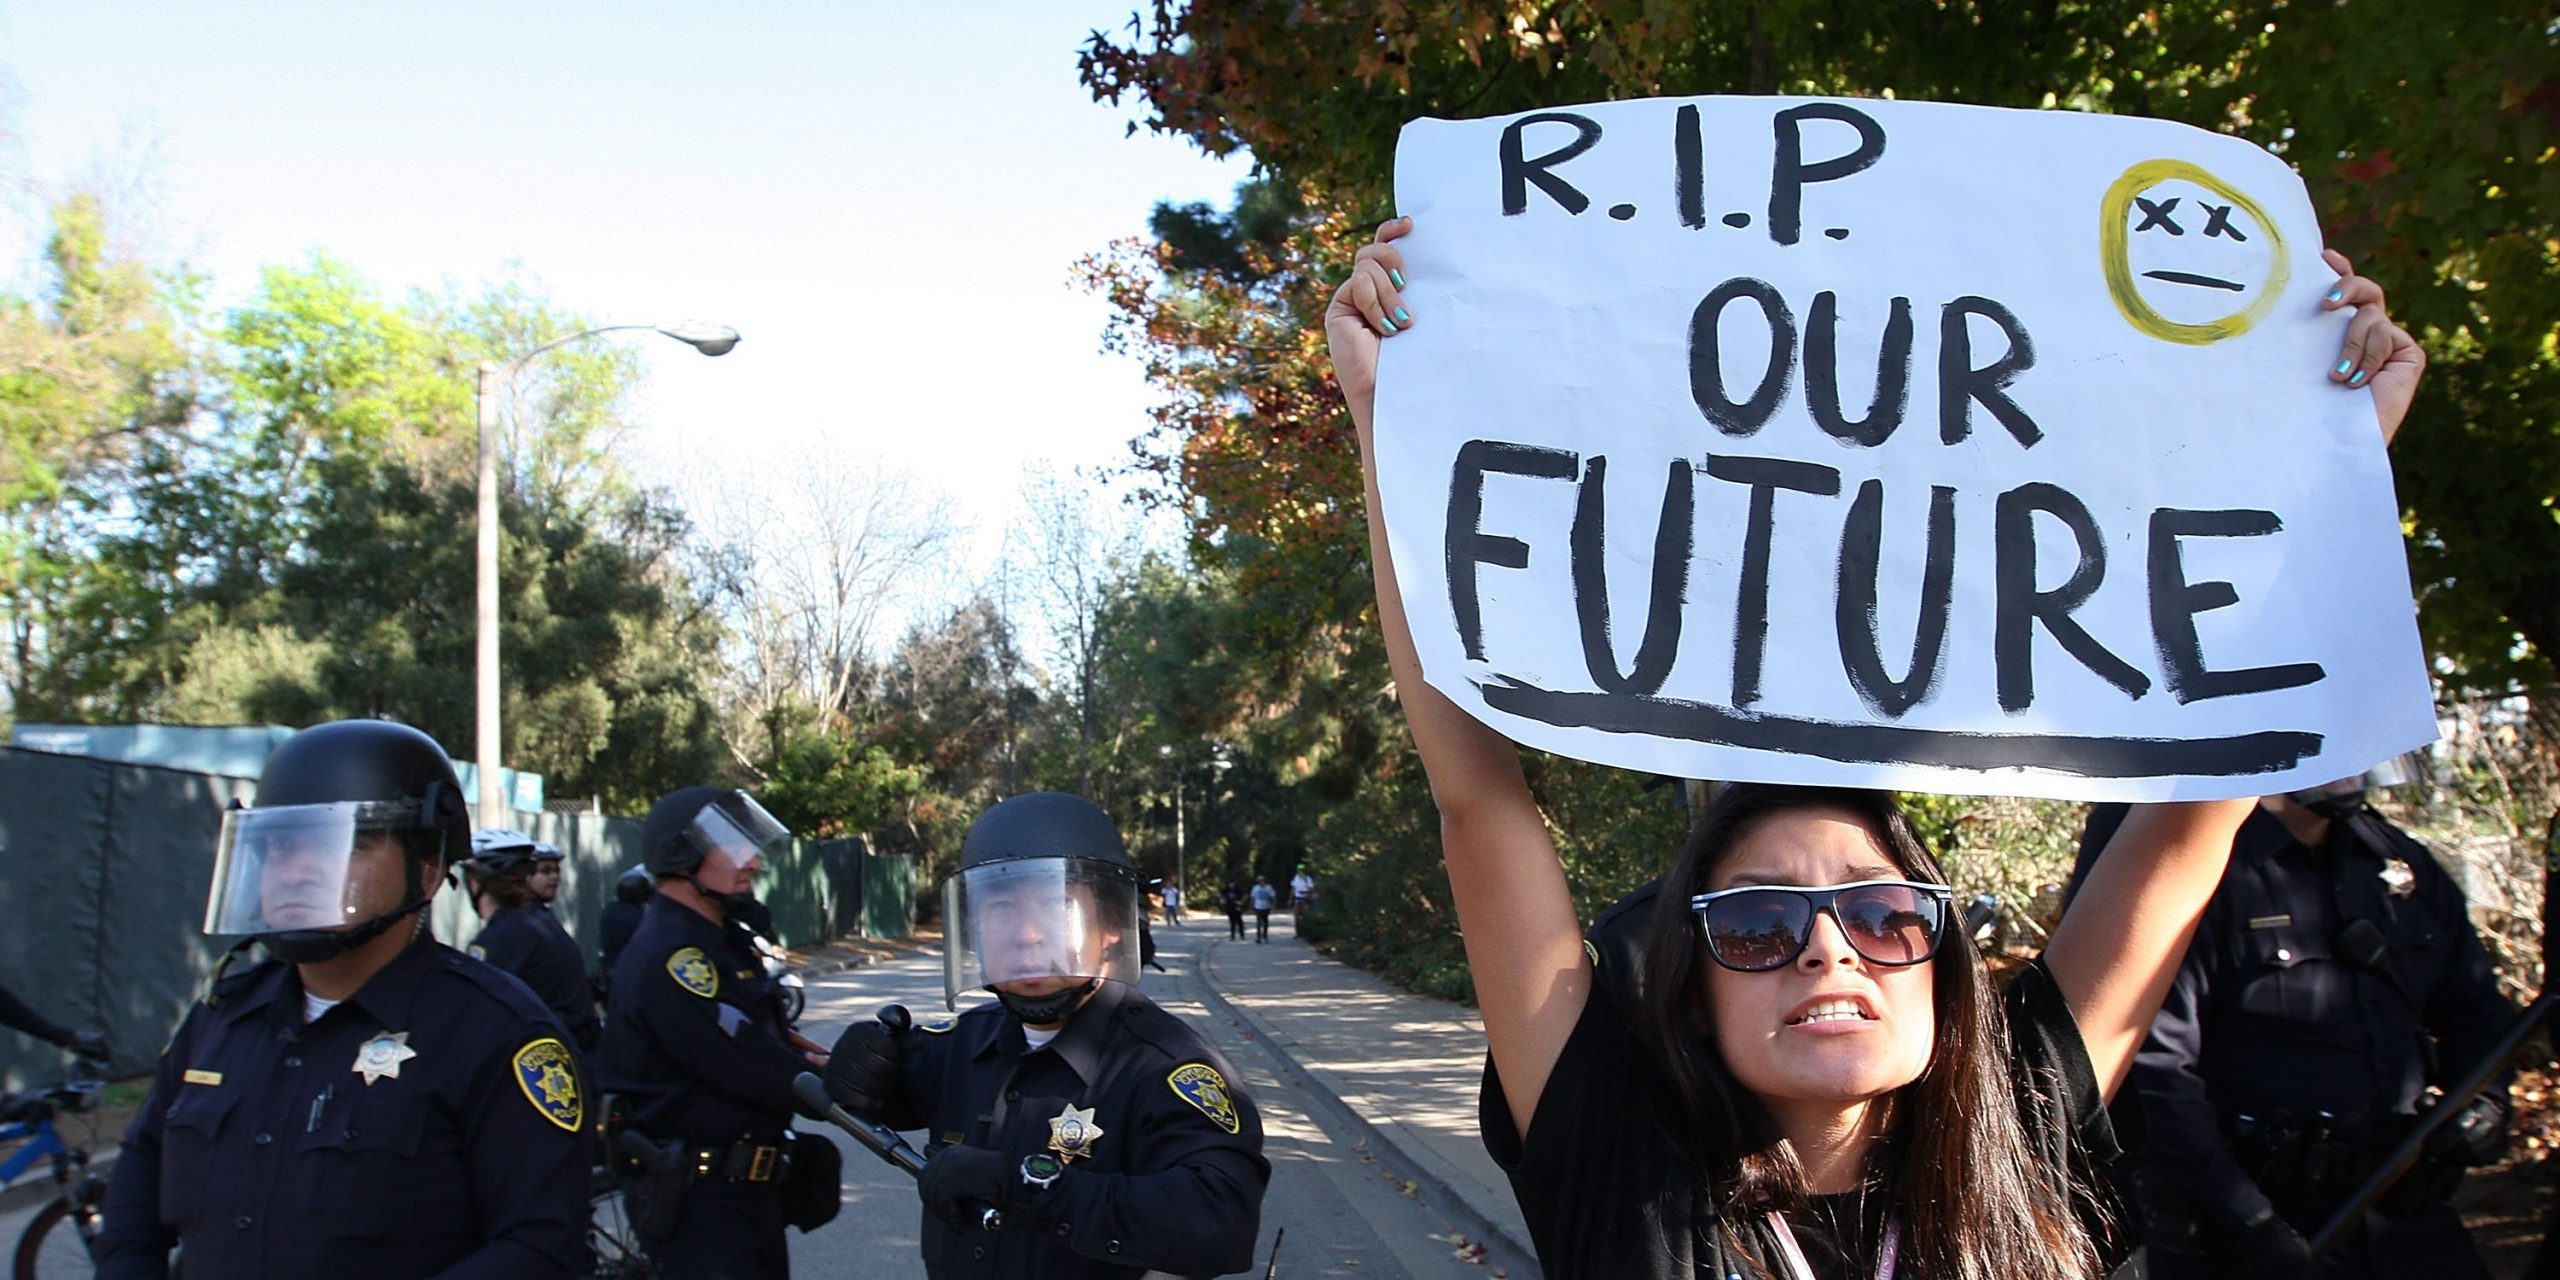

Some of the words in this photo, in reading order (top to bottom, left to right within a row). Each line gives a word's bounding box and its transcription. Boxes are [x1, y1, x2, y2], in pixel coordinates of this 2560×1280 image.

[1498, 102, 1888, 246] R.I.P.
[1689, 276, 2045, 451] OUR
[1443, 440, 2326, 719] FUTURE
